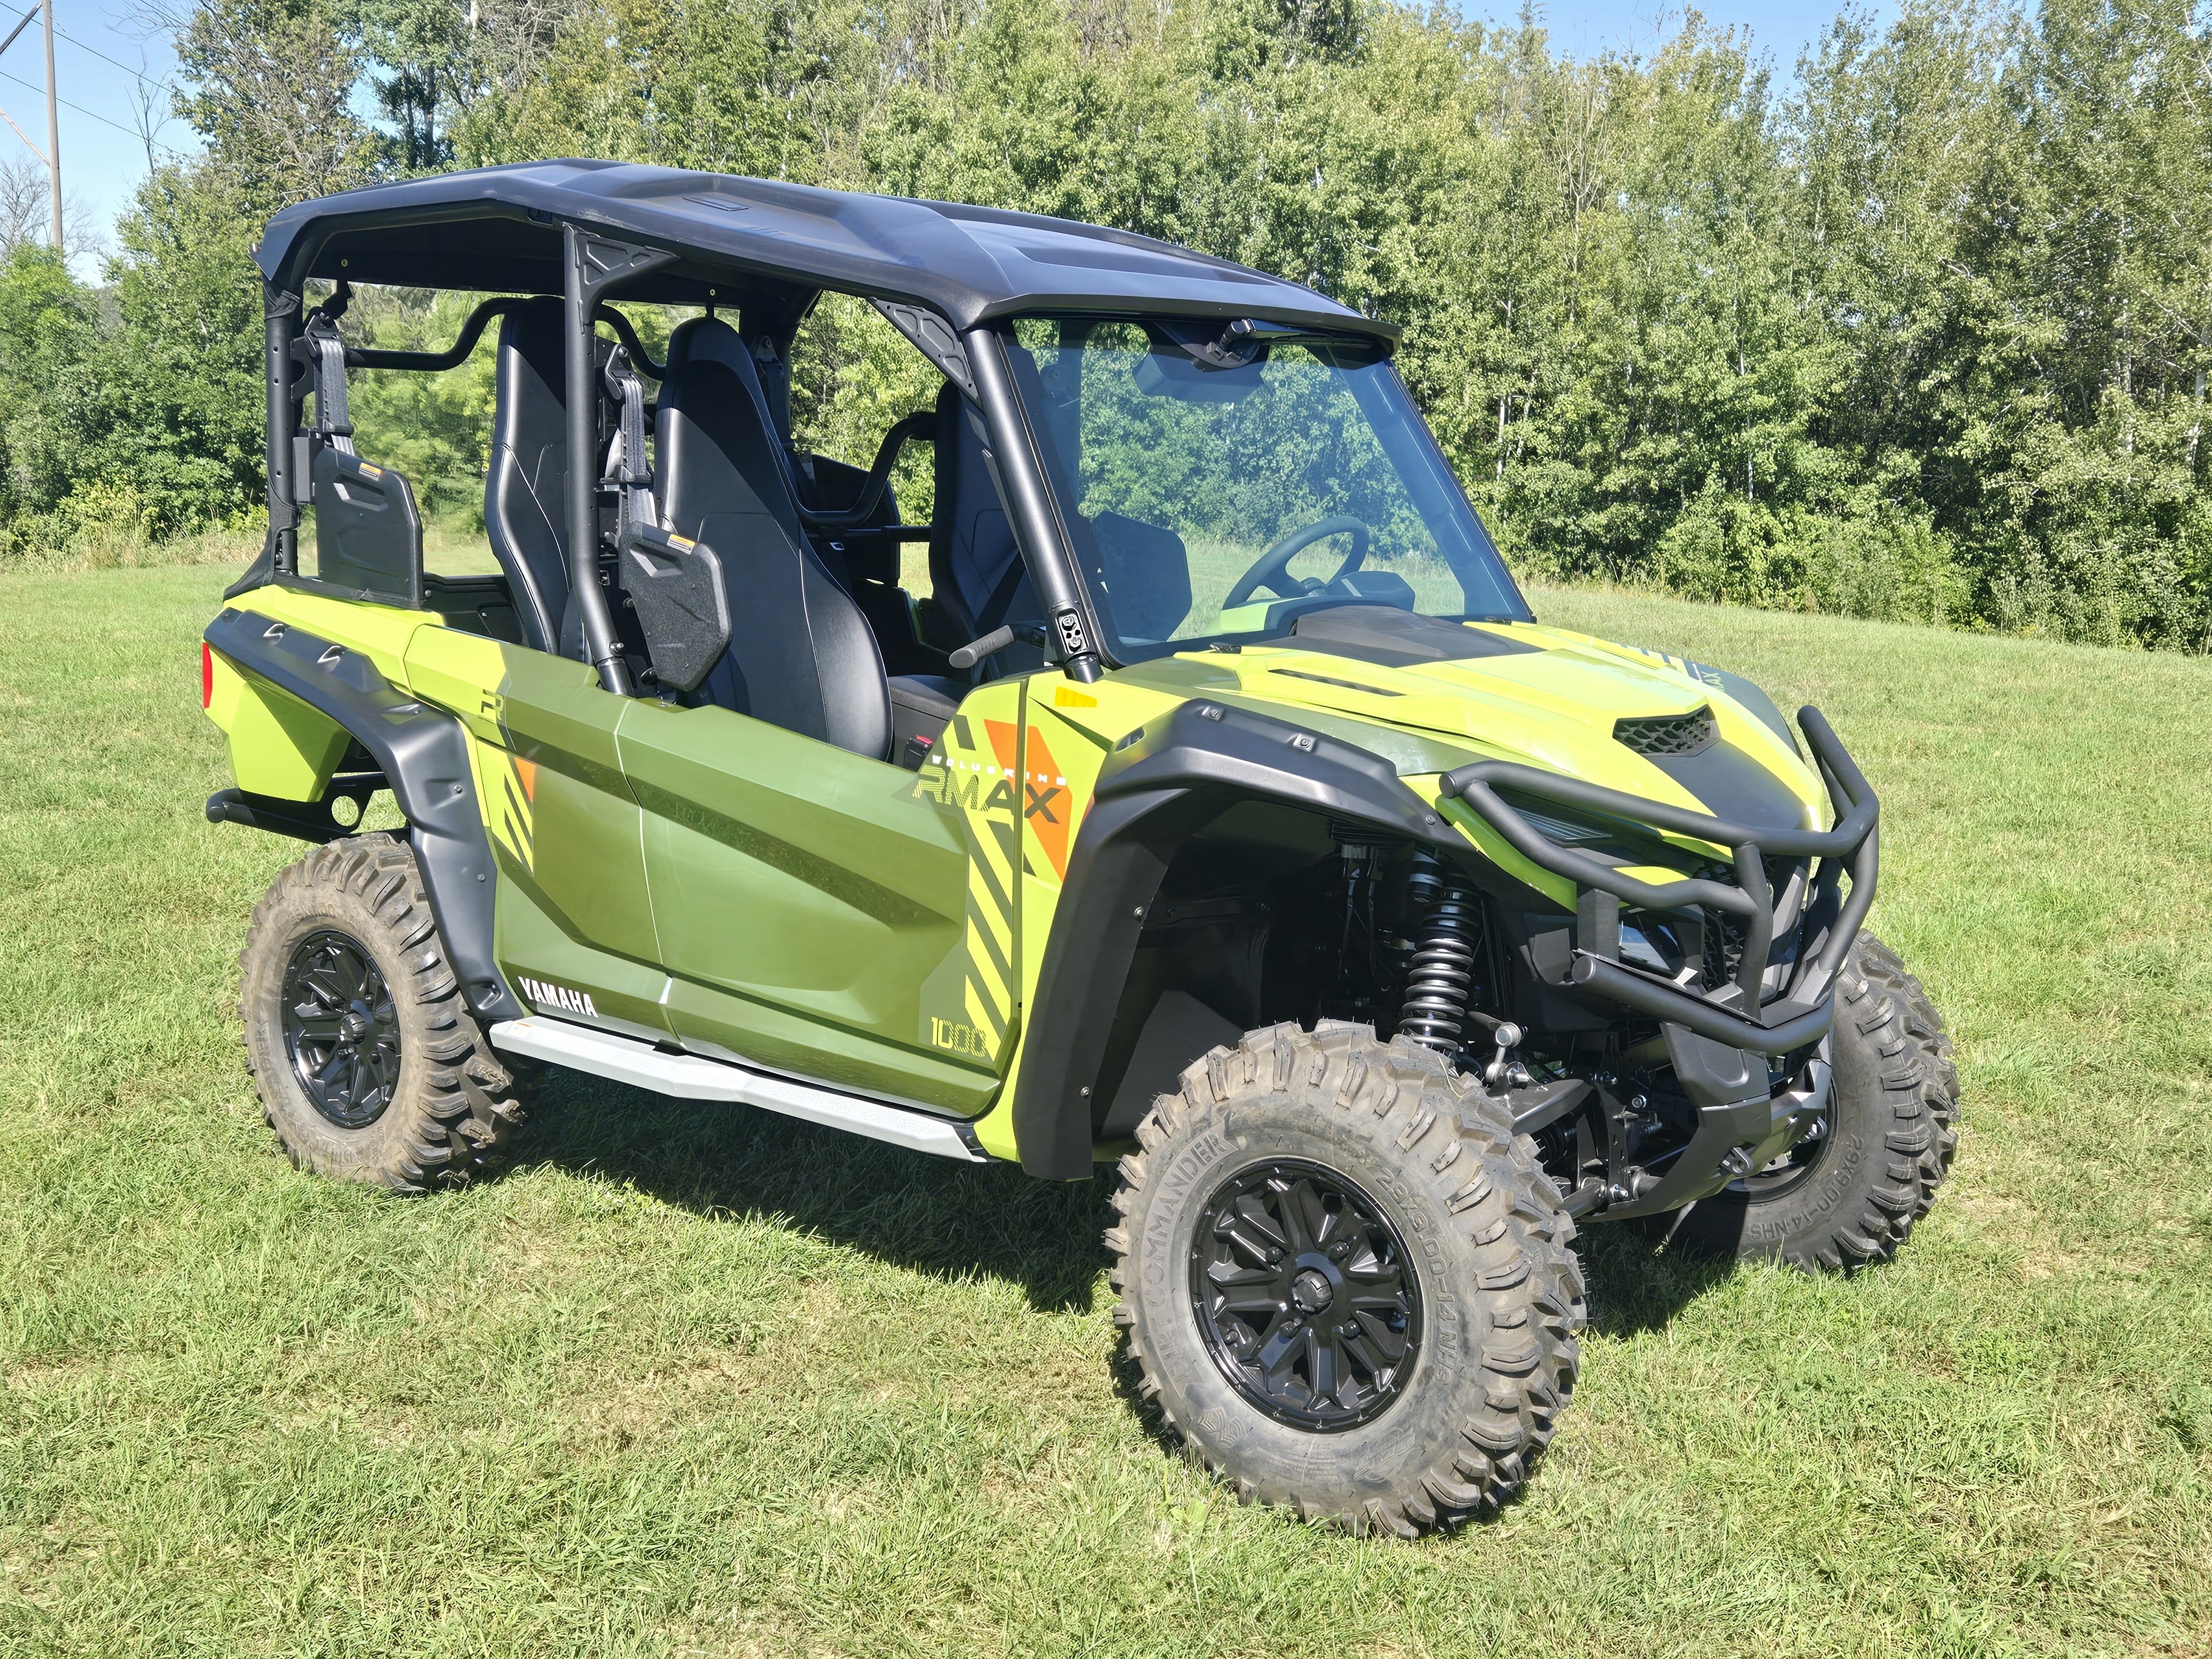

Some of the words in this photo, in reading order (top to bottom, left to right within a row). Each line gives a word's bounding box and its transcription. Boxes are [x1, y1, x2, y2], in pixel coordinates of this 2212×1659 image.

[912, 765, 1062, 825] RMAX
[518, 975, 599, 1018] YAMAHA
[931, 1016, 987, 1057] 1000
[1144, 1131, 1227, 1307] COMMANDER
